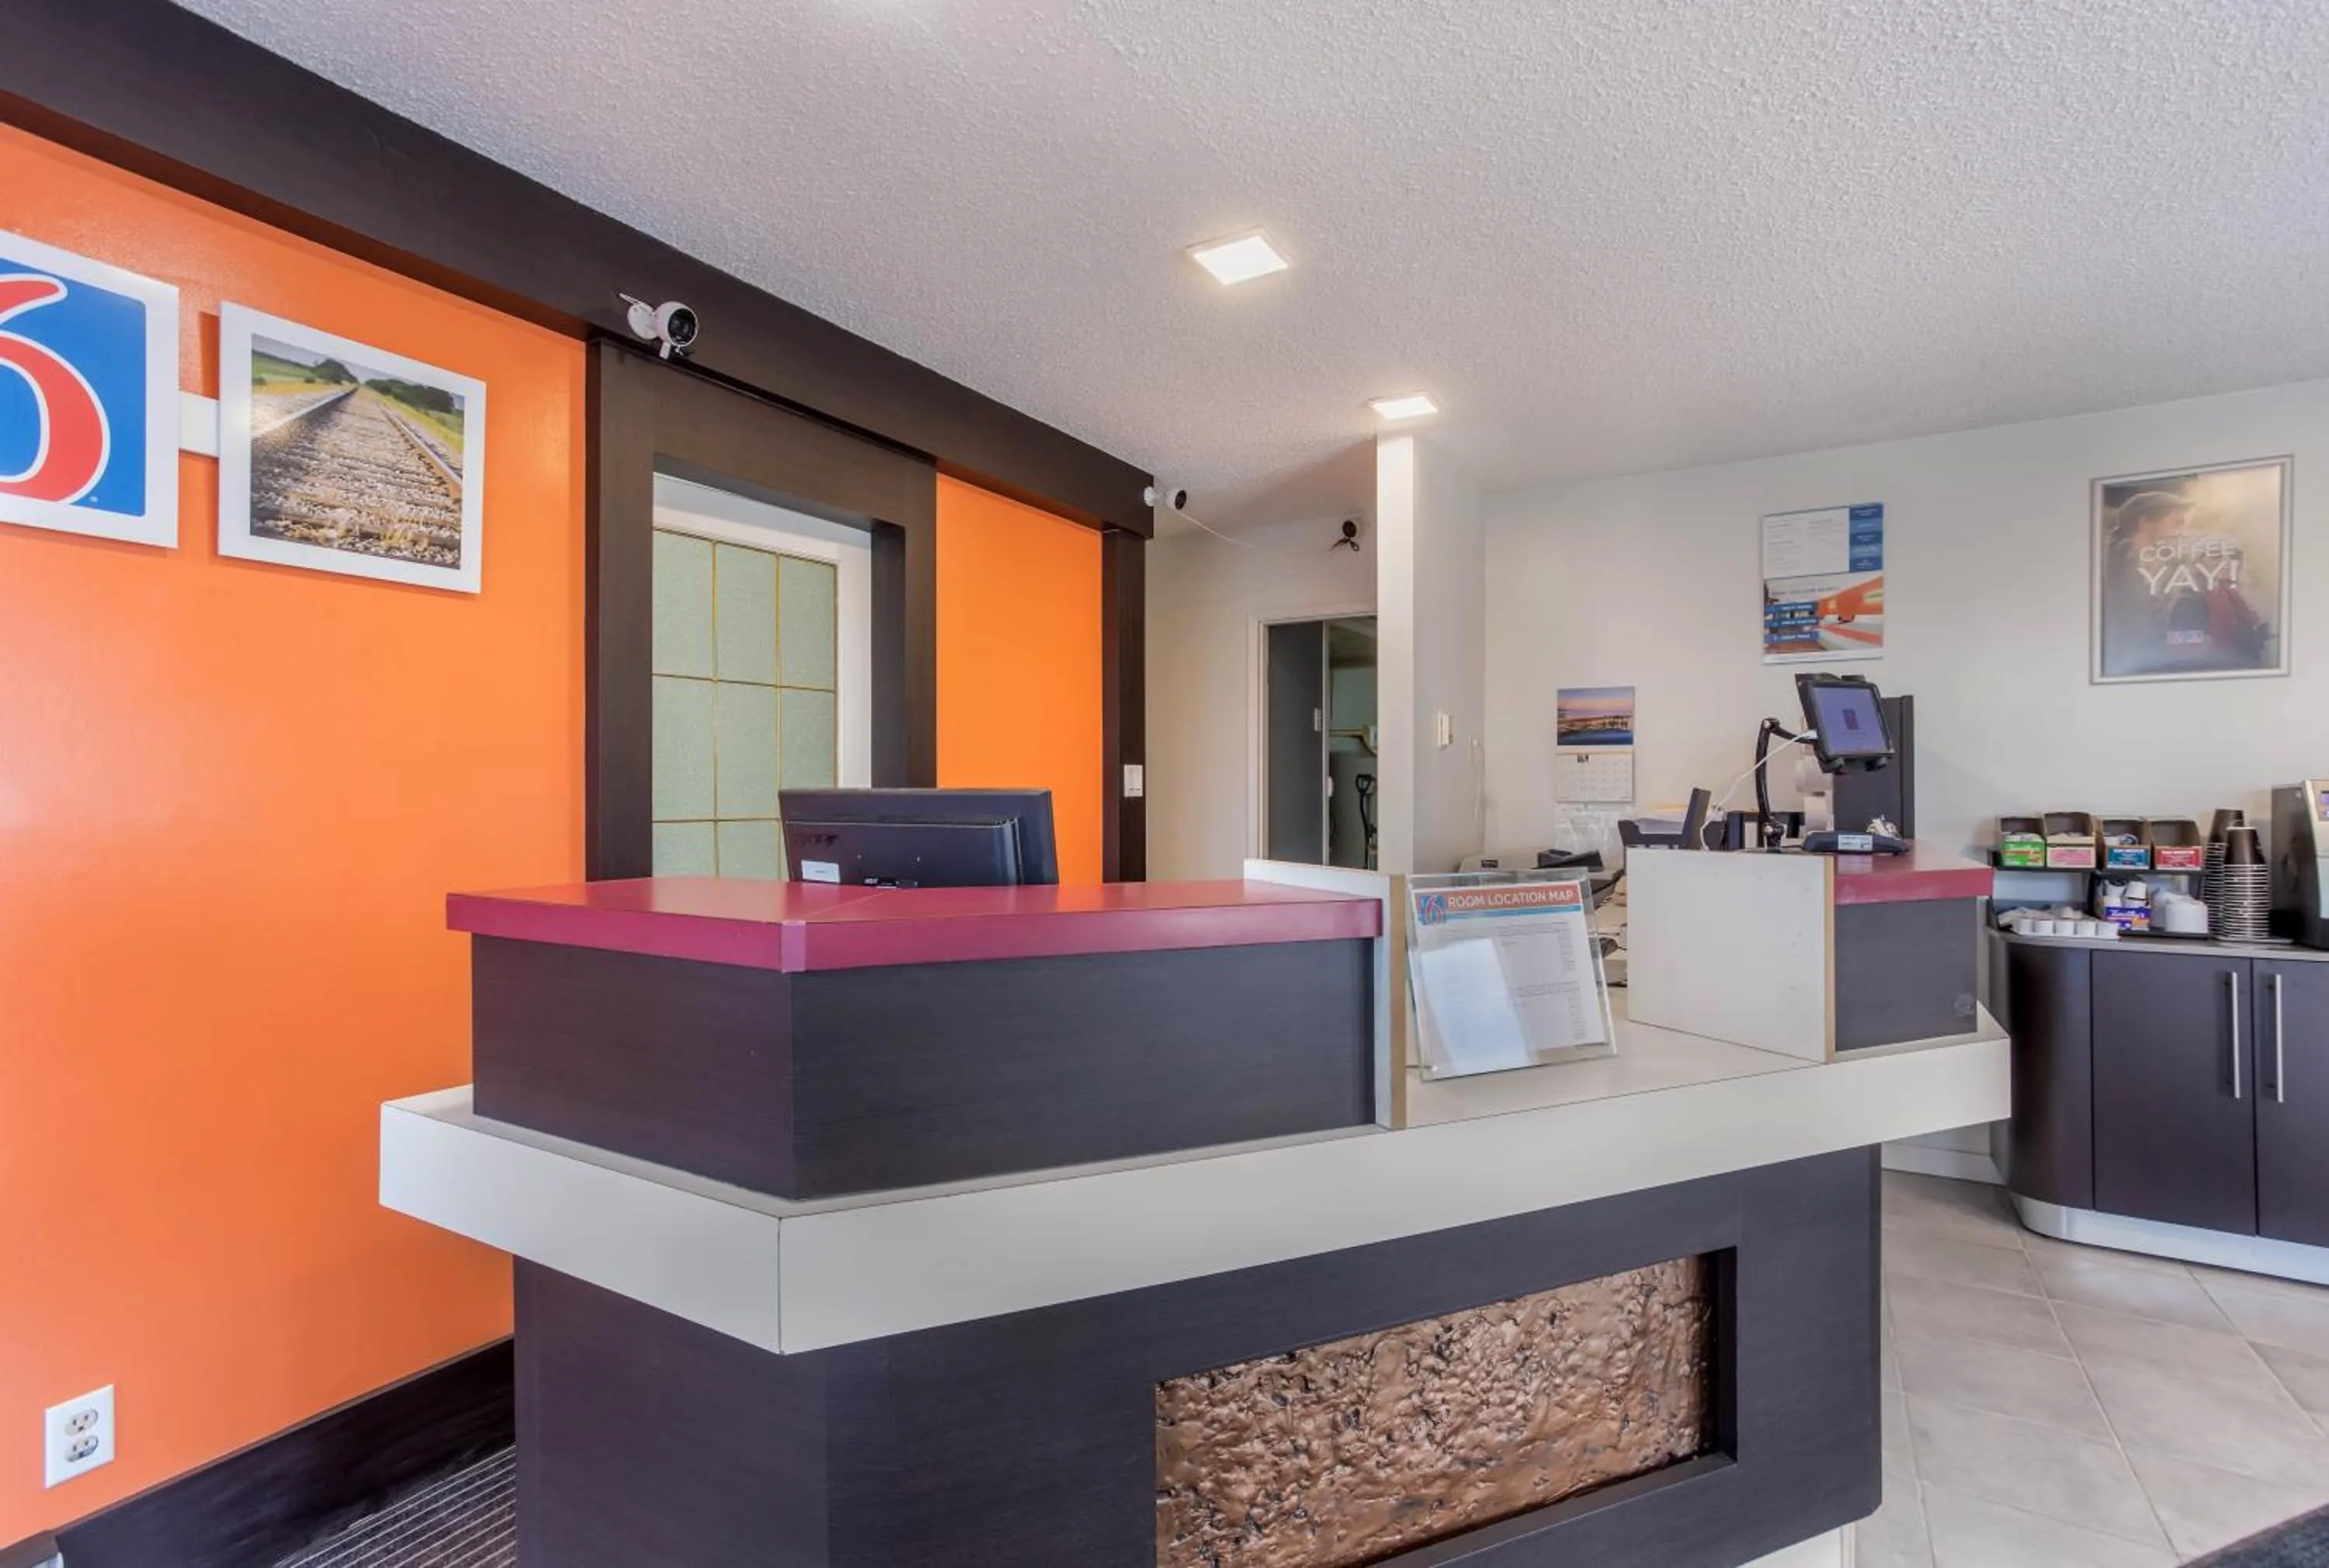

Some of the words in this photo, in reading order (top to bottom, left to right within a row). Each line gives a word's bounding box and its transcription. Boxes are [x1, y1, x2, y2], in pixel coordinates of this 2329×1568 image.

[2140, 541, 2236, 561] COFFEE
[2136, 559, 2237, 595] YAY!
[1448, 896, 1485, 907] ROOM
[1487, 892, 1546, 905] LOCATION
[1549, 890, 1573, 902] MAP
